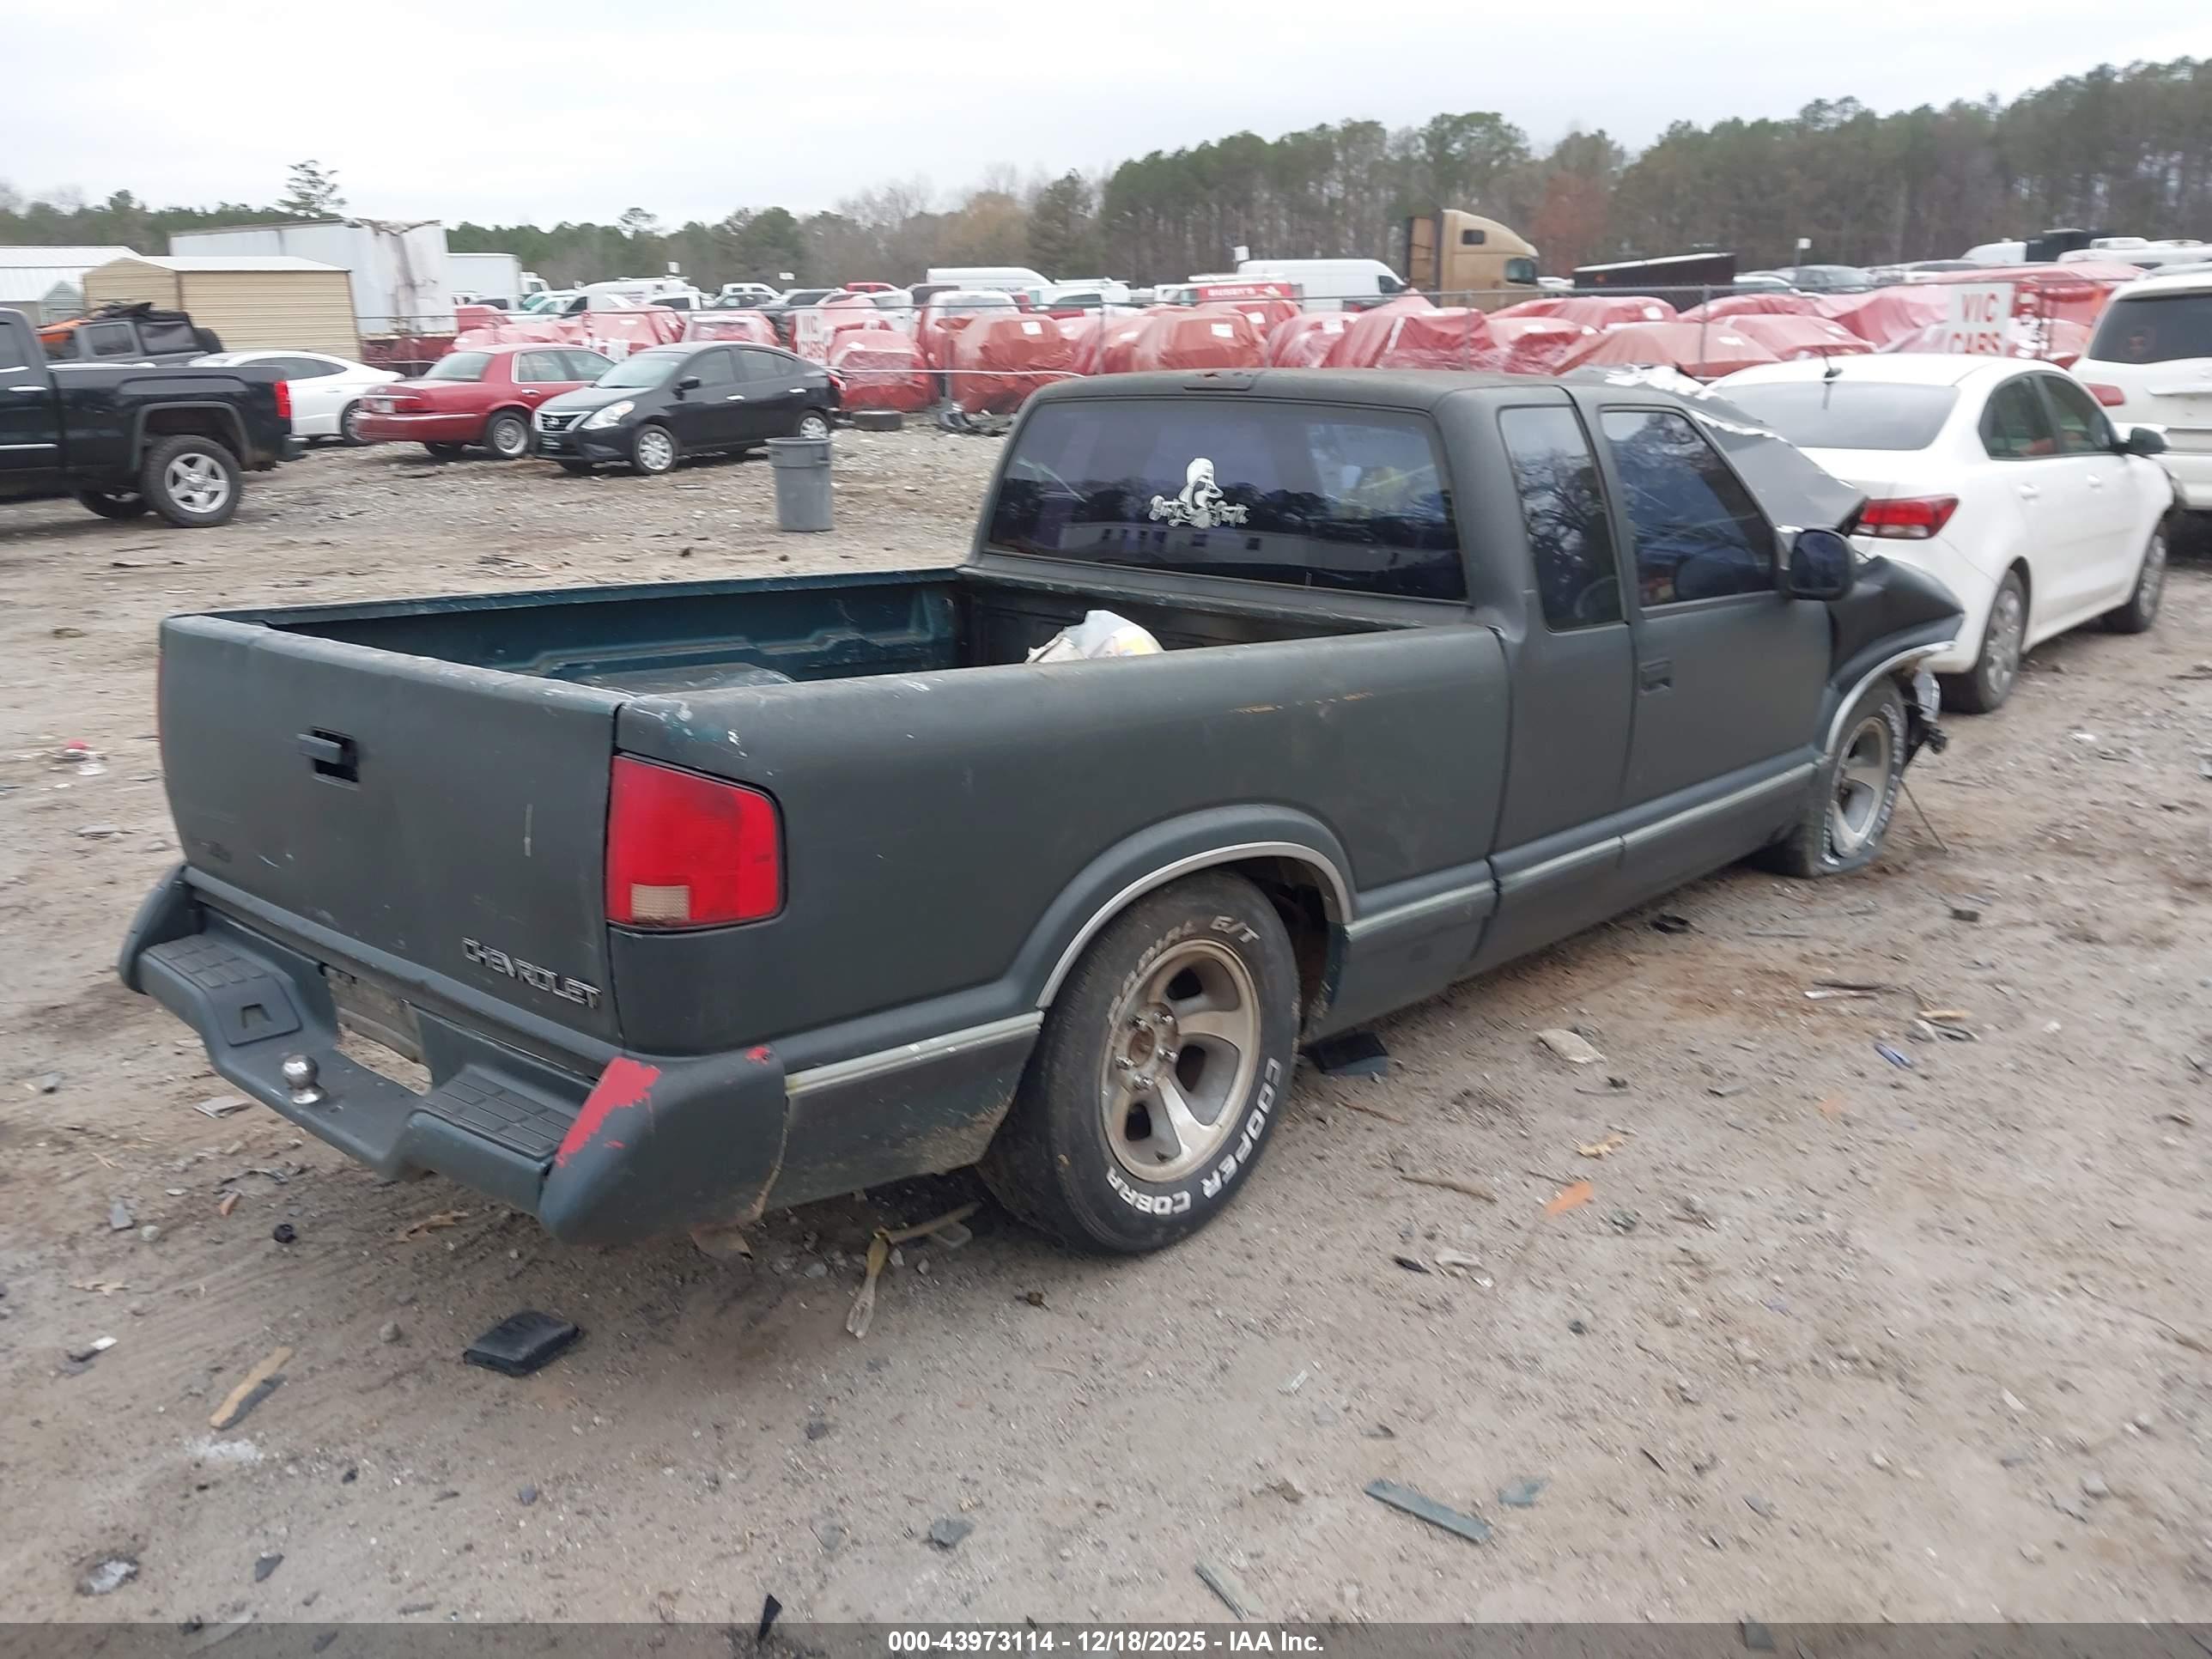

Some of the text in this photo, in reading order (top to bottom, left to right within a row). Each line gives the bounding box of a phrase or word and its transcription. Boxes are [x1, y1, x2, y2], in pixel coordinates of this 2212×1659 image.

[1961, 293, 1999, 323] VIC
[461, 936, 602, 1009] CHEVROLET
[1106, 1057, 1282, 1215] COOPER COBRA
